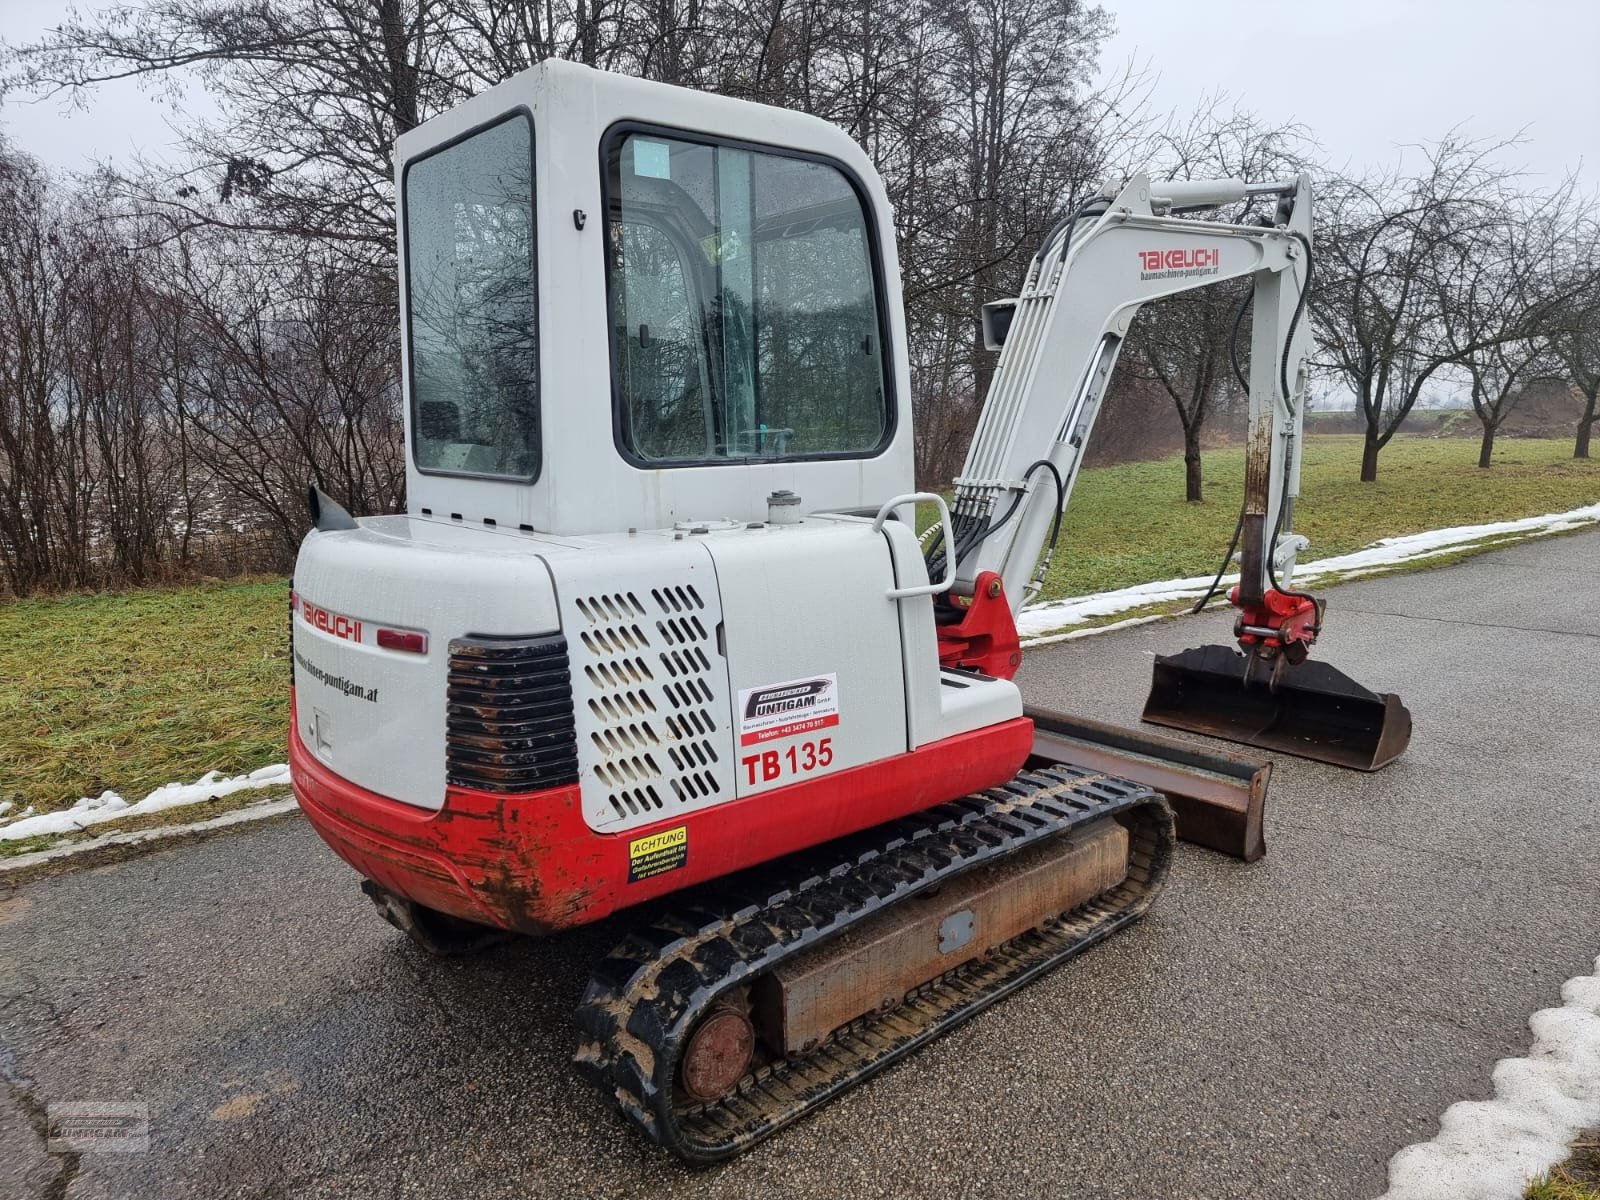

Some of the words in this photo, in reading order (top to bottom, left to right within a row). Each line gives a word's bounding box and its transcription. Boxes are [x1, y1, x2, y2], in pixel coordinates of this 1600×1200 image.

[742, 750, 781, 785] TB
[786, 737, 833, 774] 135
[633, 831, 684, 854] ACHTUNG
